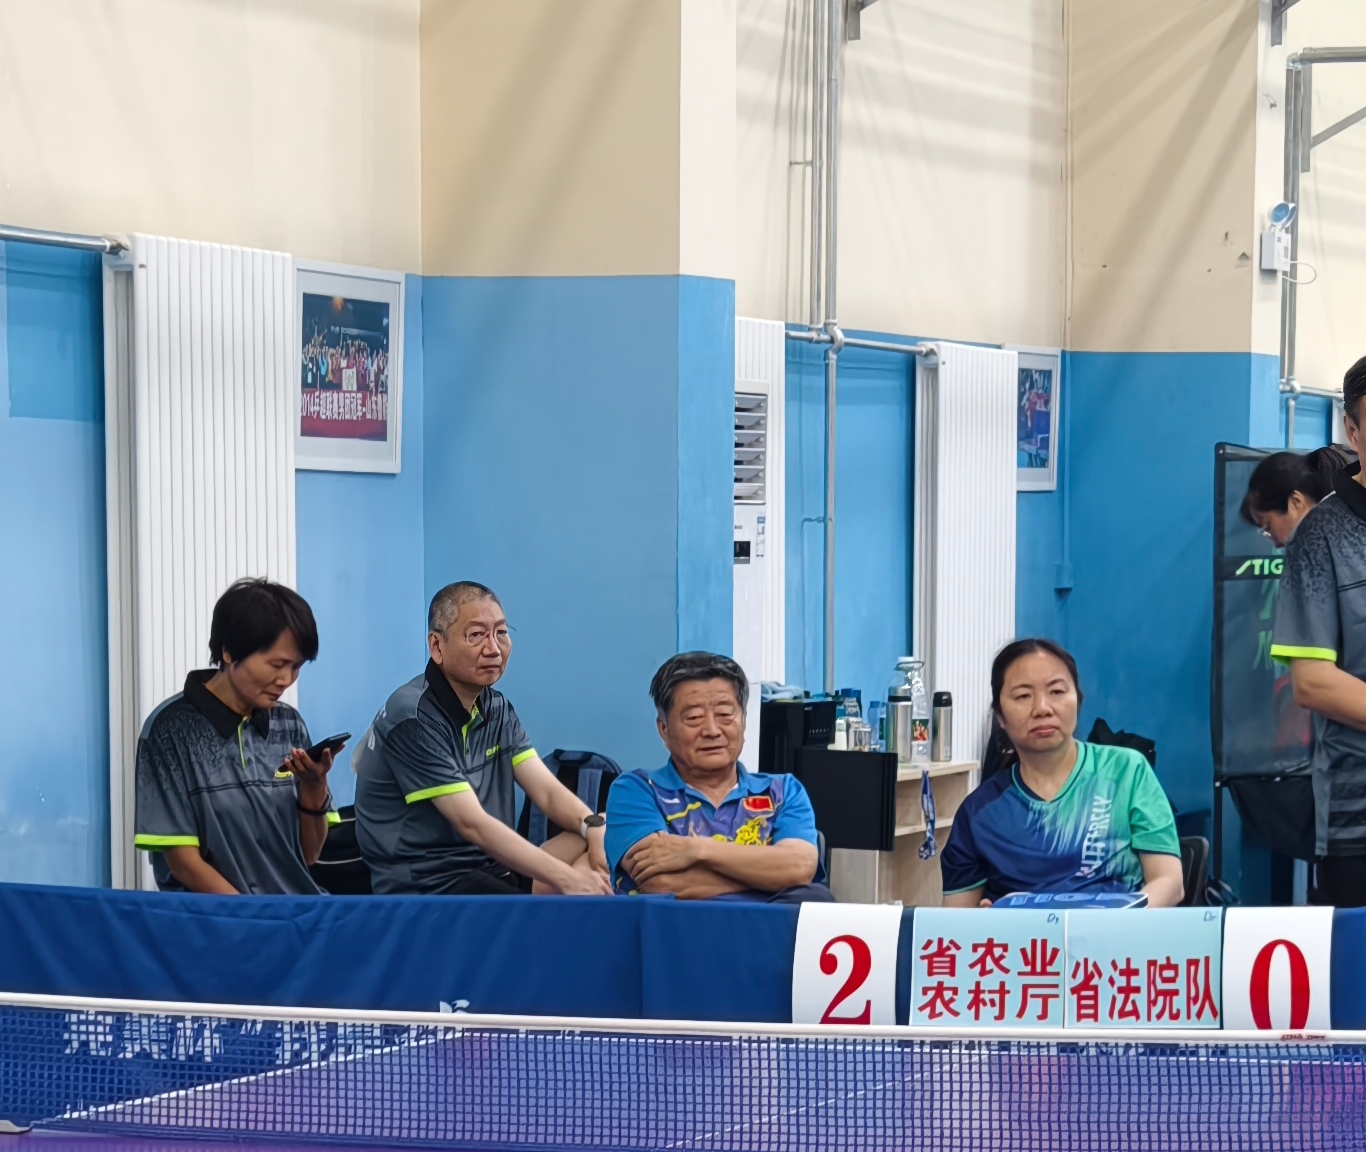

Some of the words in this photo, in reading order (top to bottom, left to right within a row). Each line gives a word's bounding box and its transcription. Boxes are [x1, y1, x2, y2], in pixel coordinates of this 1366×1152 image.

[1235, 558, 1284, 576] STIG
[818, 934, 873, 1025] 2
[919, 937, 1061, 978] 省农业
[1249, 939, 1311, 1029] 0
[917, 981, 1061, 1021] 农村厅
[1069, 956, 1220, 1024] 省法院队
